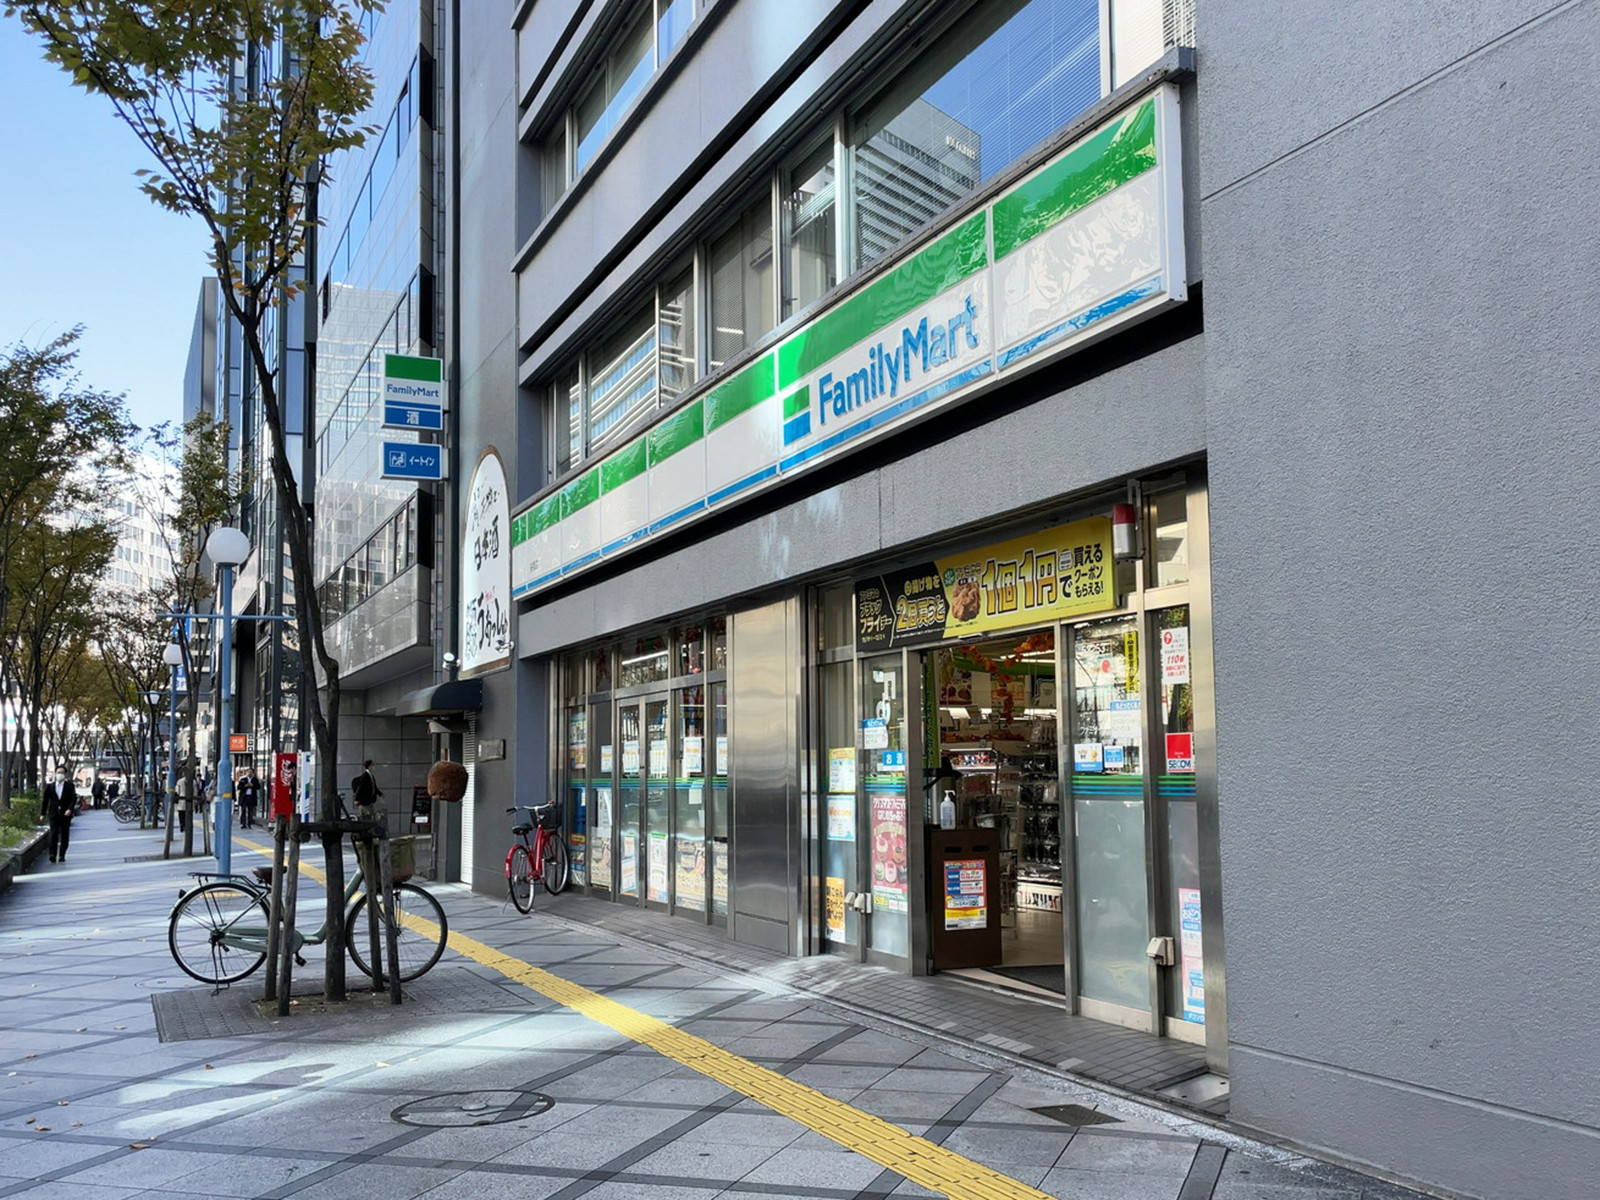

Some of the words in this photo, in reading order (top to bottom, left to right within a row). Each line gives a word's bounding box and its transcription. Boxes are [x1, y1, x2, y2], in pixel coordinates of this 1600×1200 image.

[819, 293, 980, 425] FamilyMart
[386, 383, 440, 398] FamilyMart
[406, 411, 420, 425] 酒
[409, 456, 435, 467] イートイン
[1074, 543, 1103, 568] 買える
[1074, 565, 1103, 584] クーポン
[1059, 574, 1073, 598] で
[1168, 757, 1192, 769] SECOM
